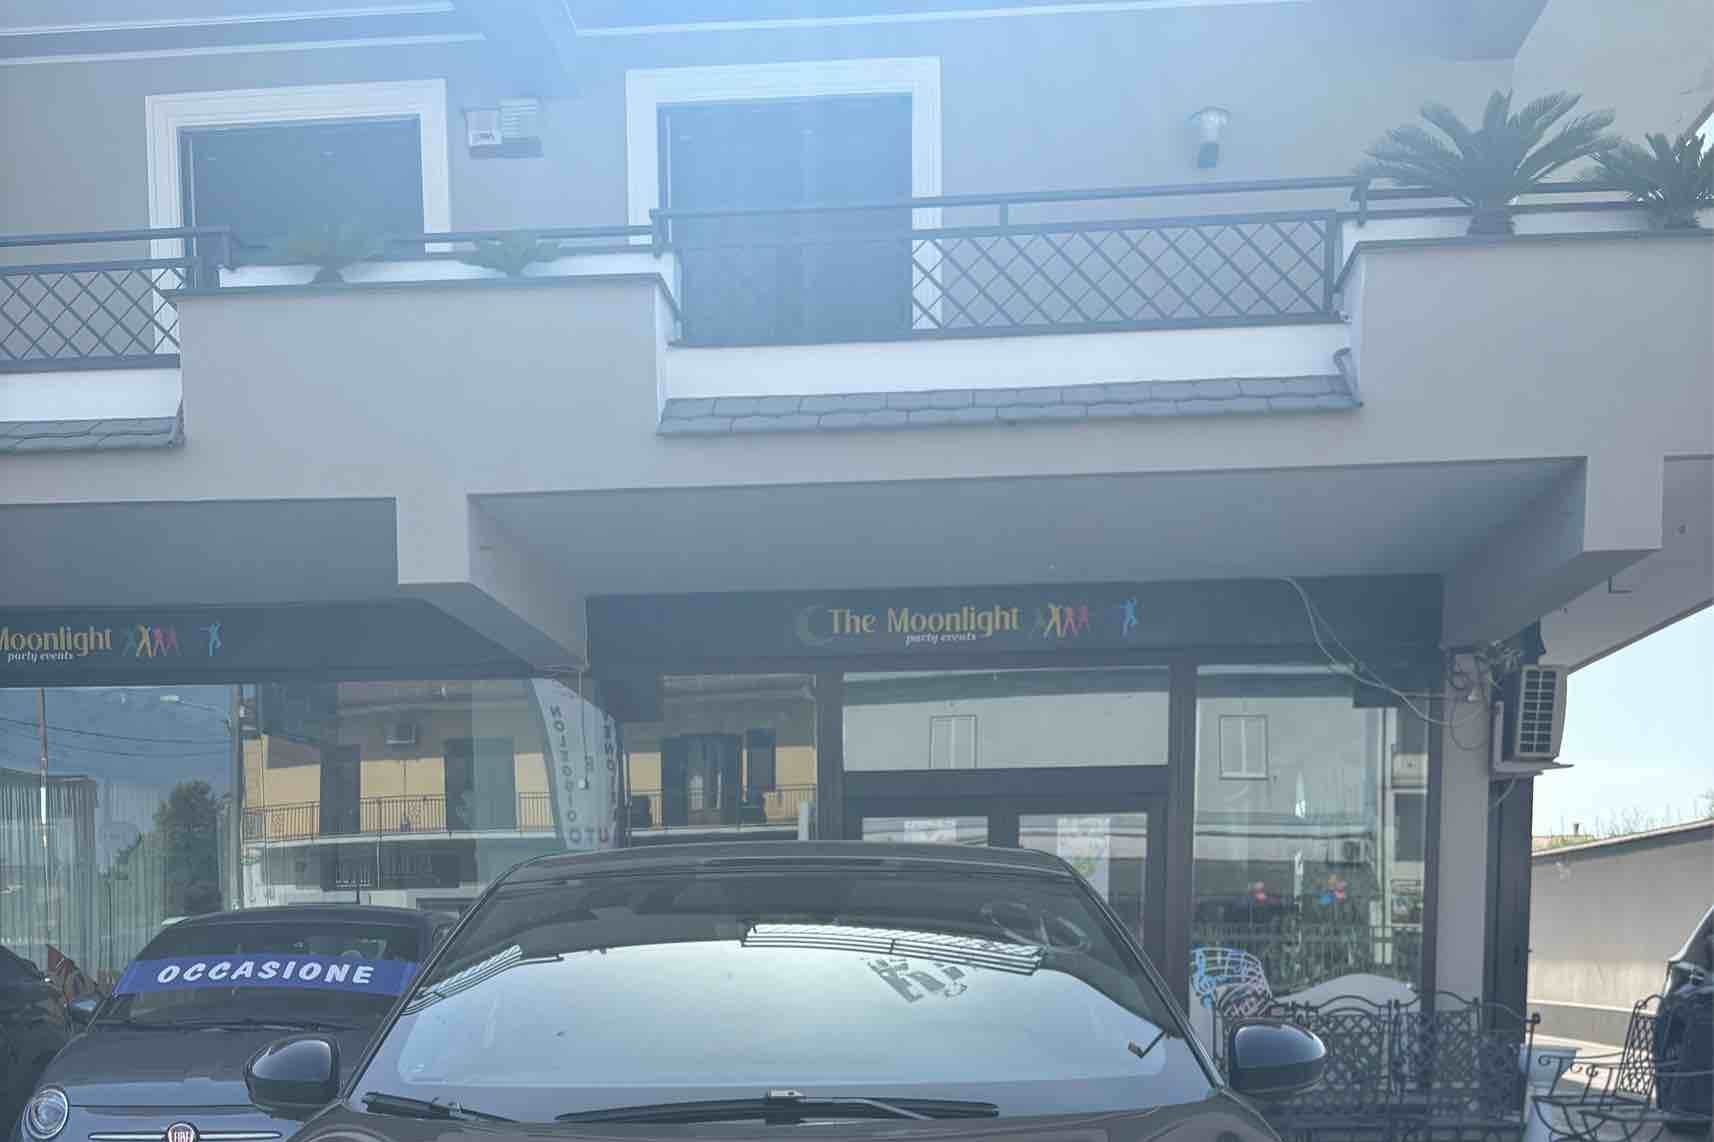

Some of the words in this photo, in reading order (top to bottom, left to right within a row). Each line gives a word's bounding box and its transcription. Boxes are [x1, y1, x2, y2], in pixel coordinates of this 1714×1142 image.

[827, 608, 876, 633] The
[887, 604, 1019, 638] Moonlight
[904, 632, 938, 646] party
[940, 631, 977, 641] events
[8, 651, 38, 664] party
[40, 651, 73, 661] events
[157, 961, 375, 984] OCCASIONE
